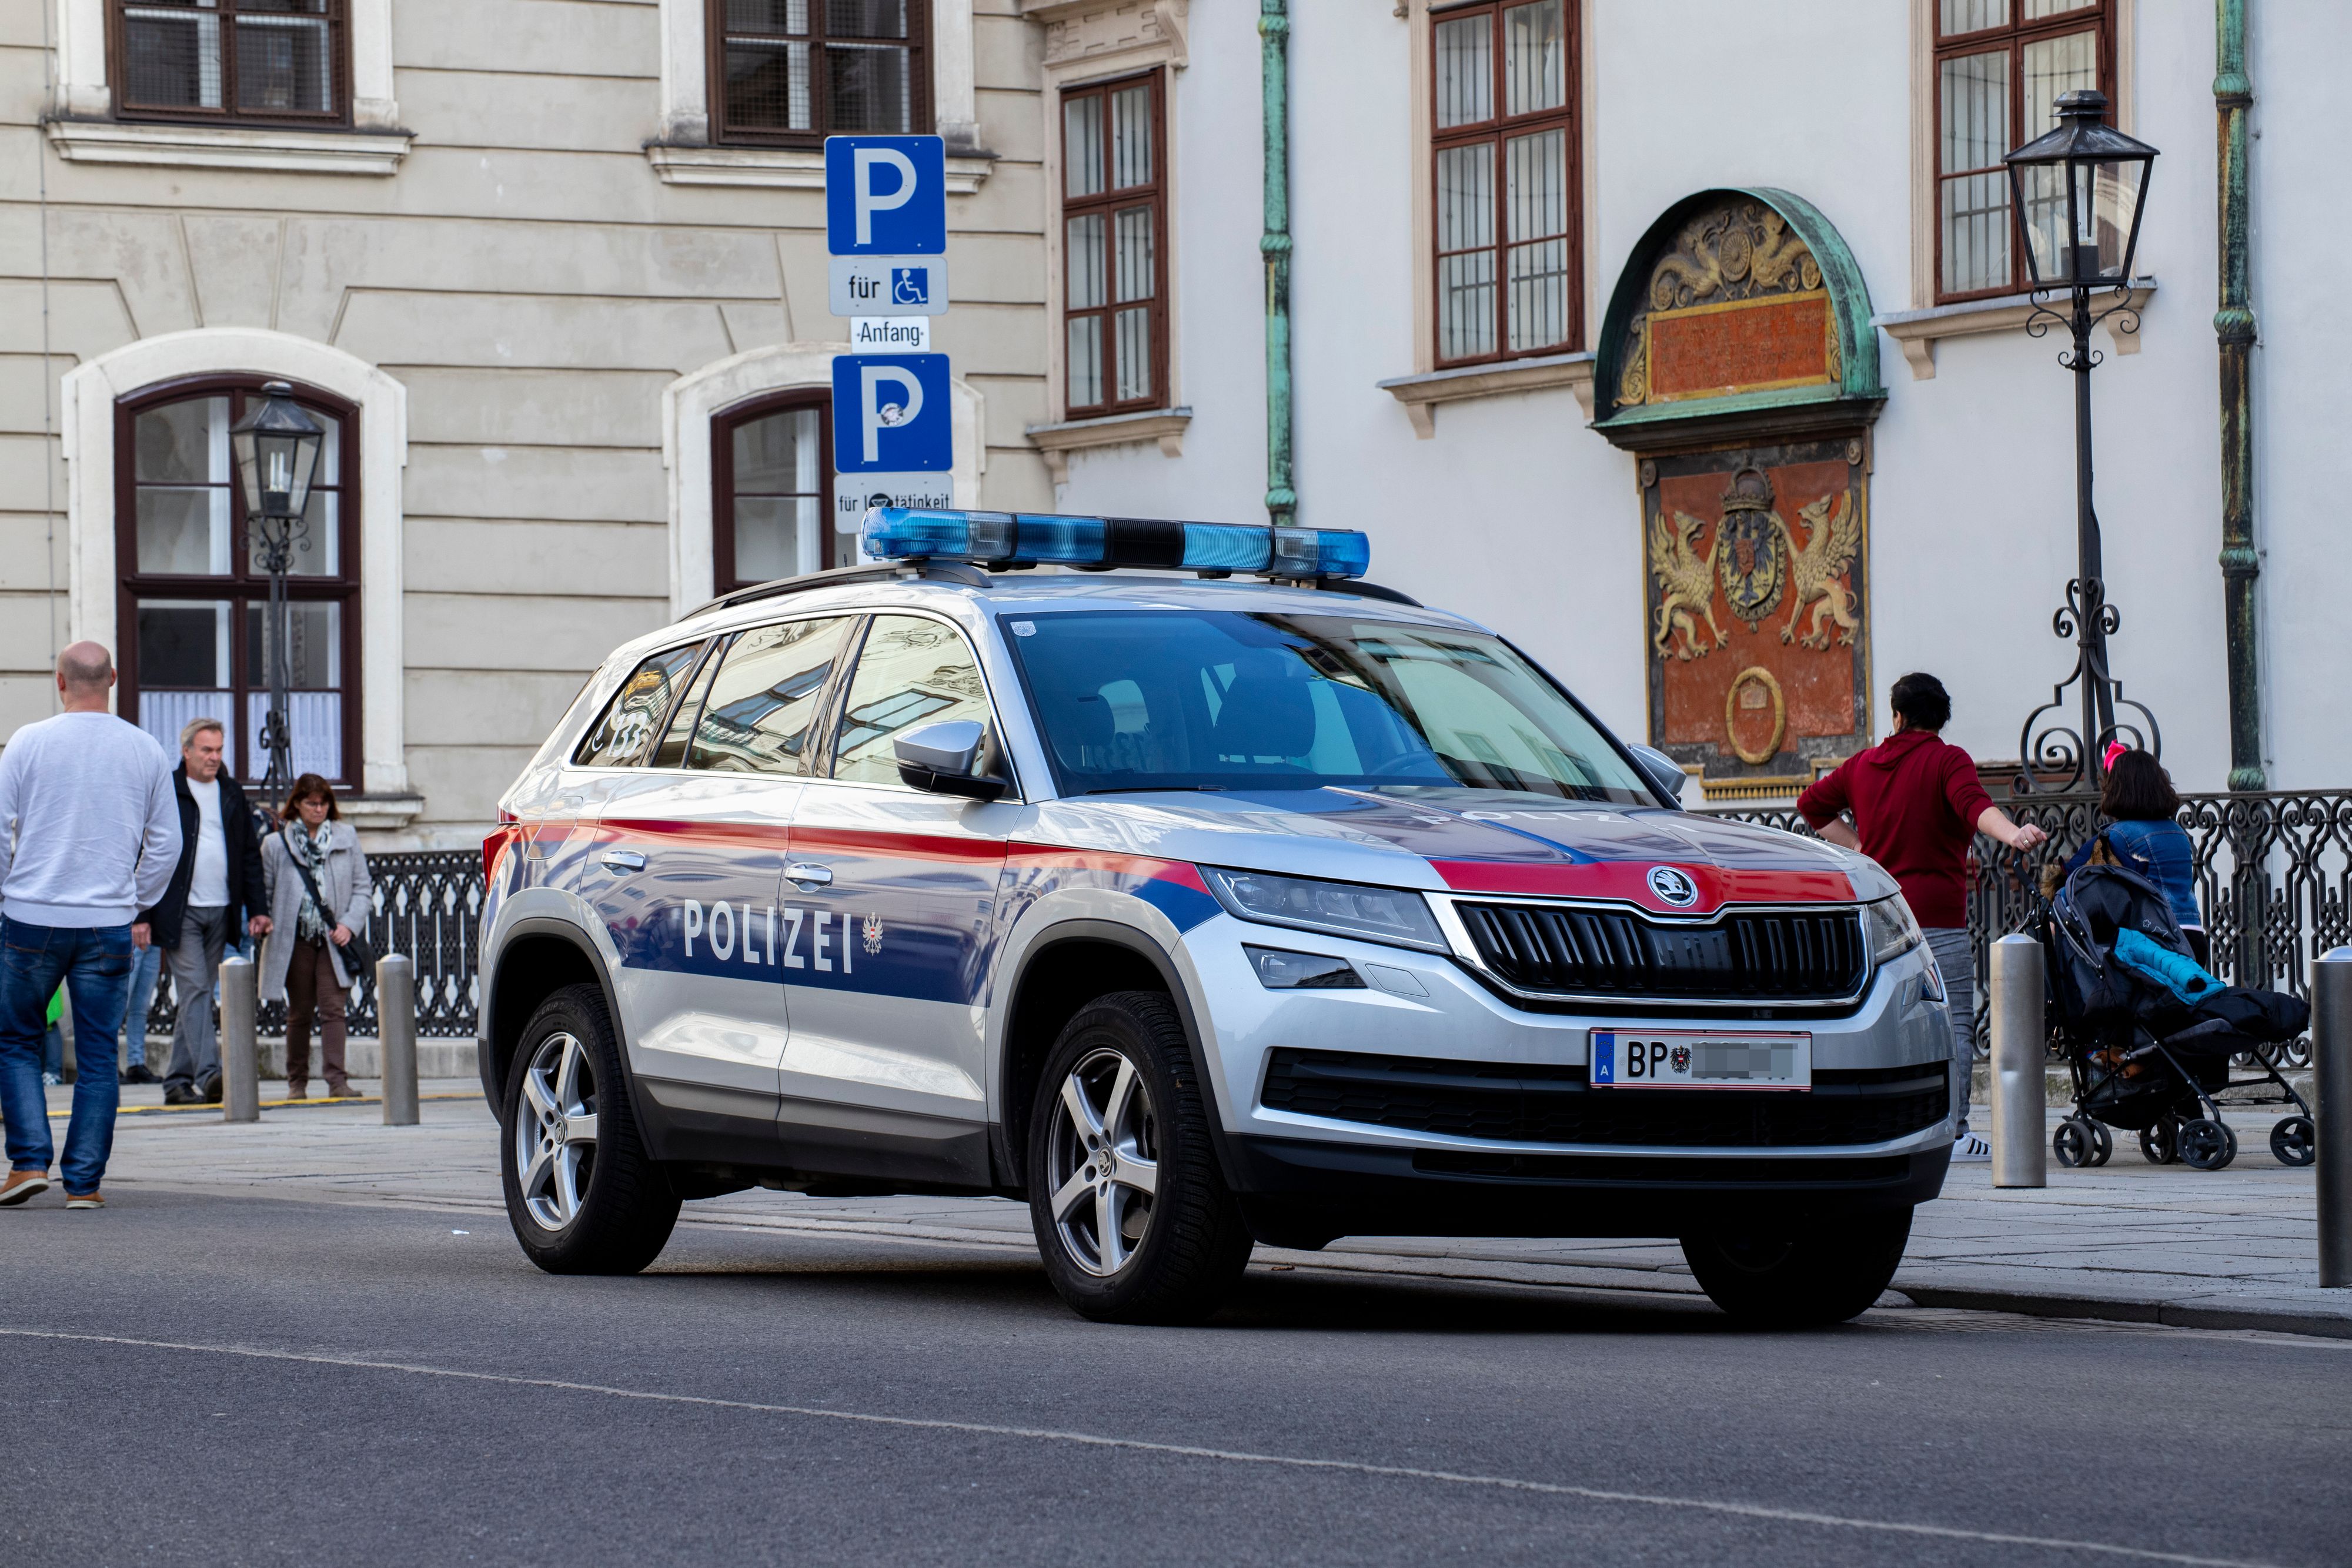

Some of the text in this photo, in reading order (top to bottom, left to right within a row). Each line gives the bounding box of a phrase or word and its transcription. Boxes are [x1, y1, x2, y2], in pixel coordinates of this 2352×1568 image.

[854, 148, 917, 245] P
[848, 275, 880, 299] für
[860, 322, 920, 346] Anfang
[861, 366, 924, 462] P
[839, 495, 858, 512] für
[606, 712, 647, 758] 133
[684, 899, 851, 974] POLIZEI
[1600, 1065, 1609, 1076] A
[1628, 1041, 1668, 1078] BP
